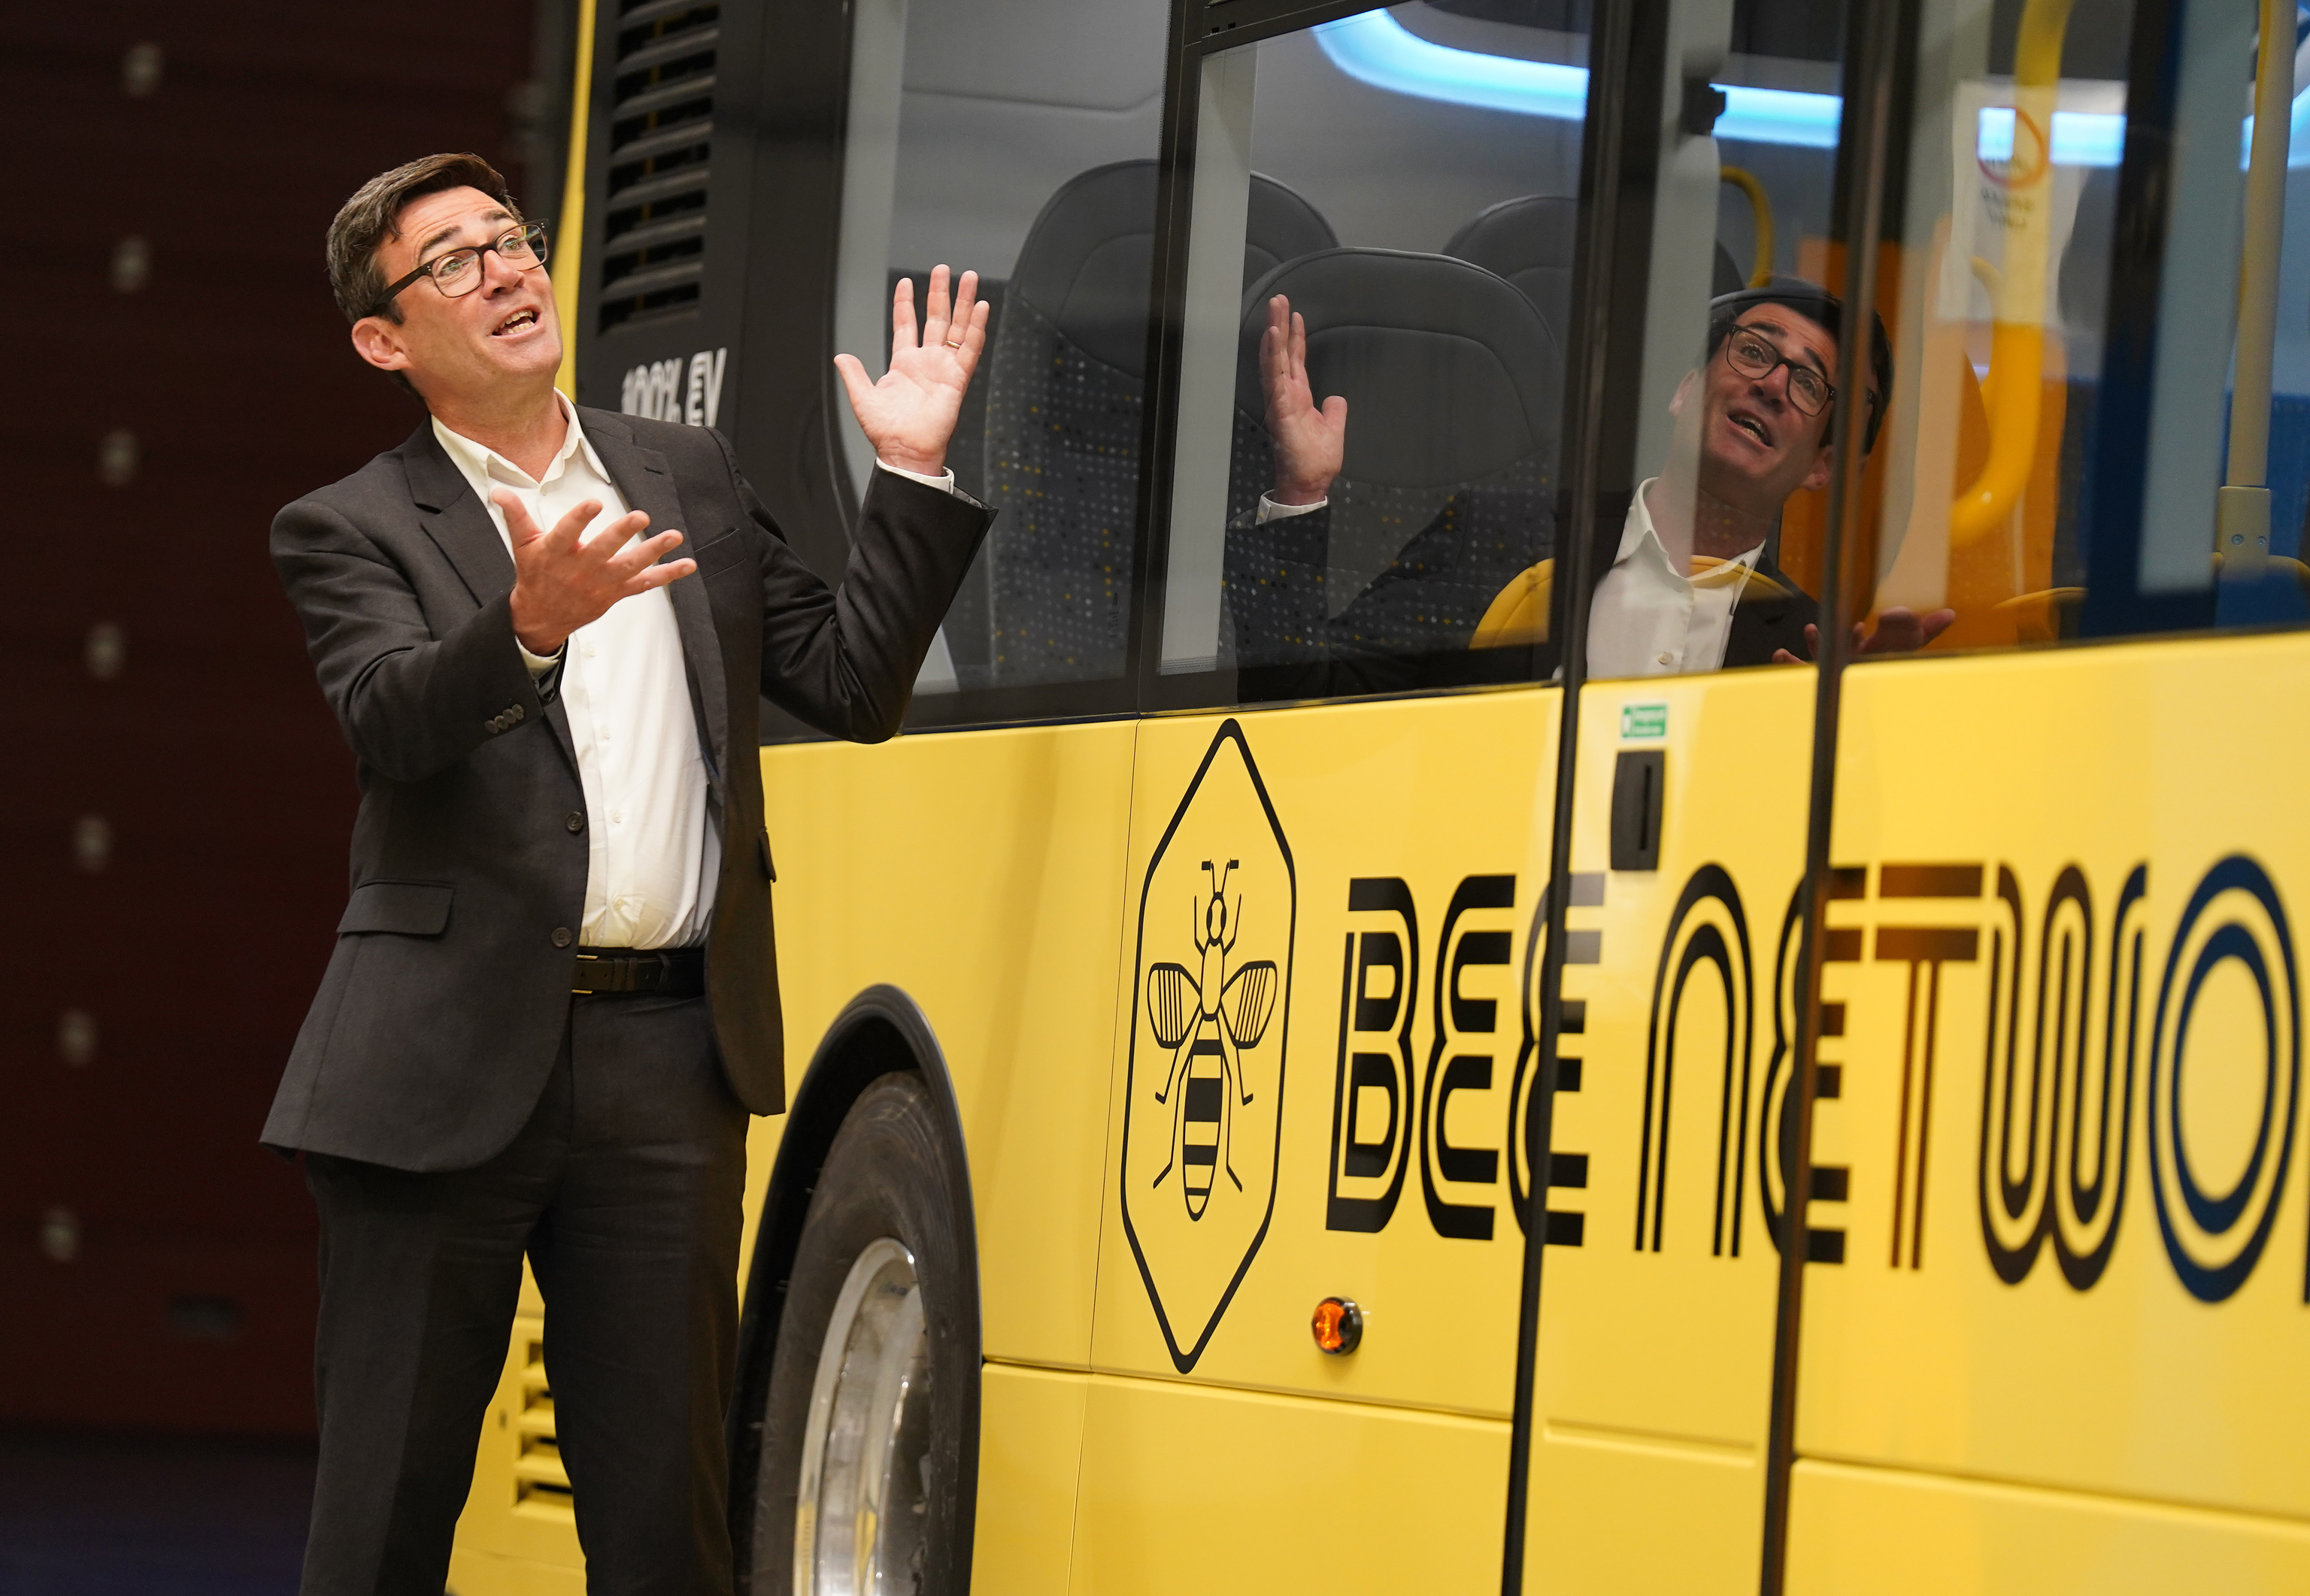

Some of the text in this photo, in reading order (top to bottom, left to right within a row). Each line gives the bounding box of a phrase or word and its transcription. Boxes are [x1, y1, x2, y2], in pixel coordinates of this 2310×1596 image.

[685, 347, 727, 428] EV
[1325, 853, 2310, 1305] BEE NETWO
